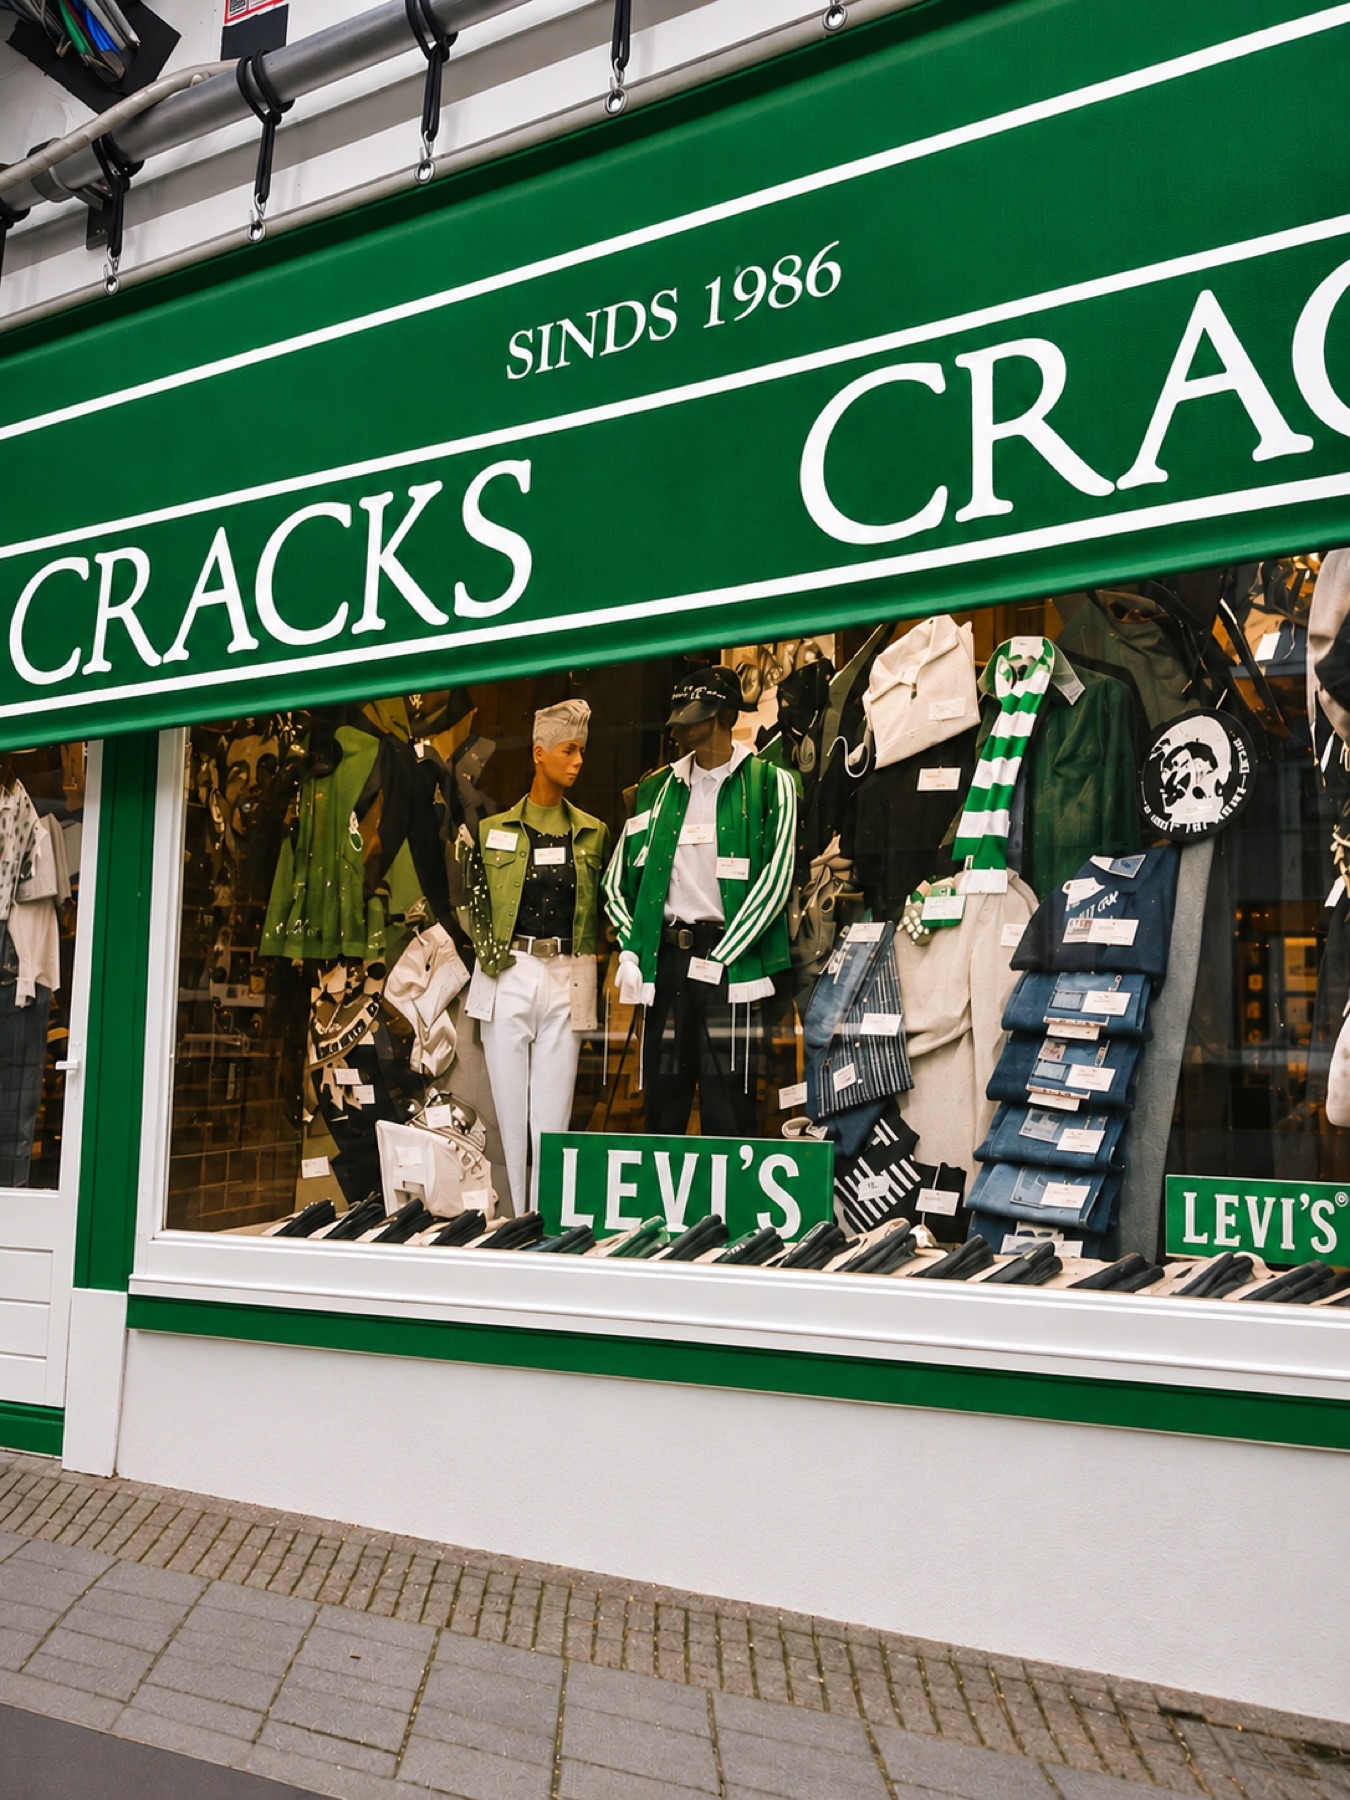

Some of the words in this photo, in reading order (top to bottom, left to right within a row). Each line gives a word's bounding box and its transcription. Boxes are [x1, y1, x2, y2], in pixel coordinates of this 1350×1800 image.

[505, 287, 678, 381] SINDS
[703, 240, 842, 329] 1986
[9, 459, 533, 686] CRACKS
[560, 1144, 802, 1241] LEVI'S
